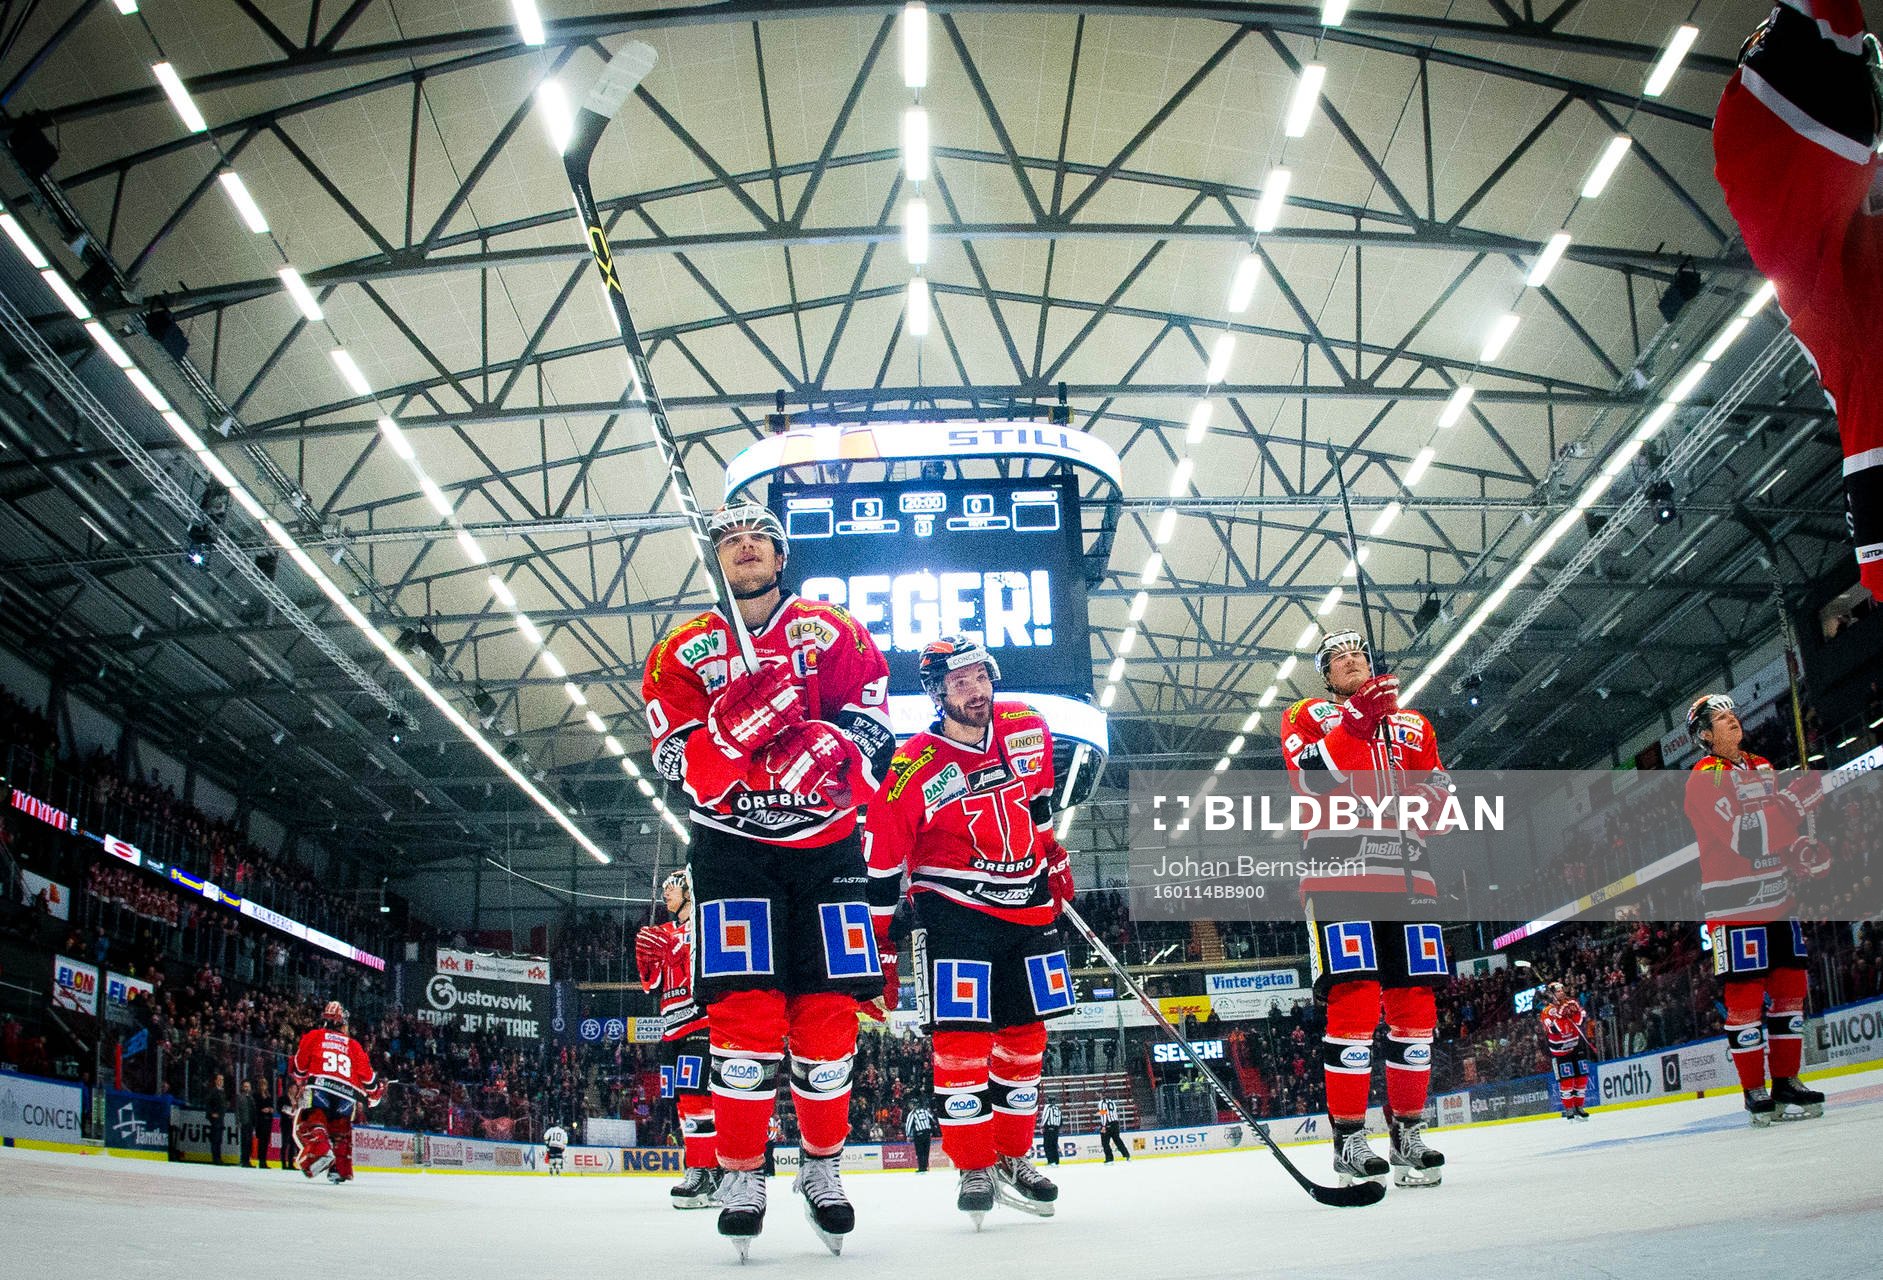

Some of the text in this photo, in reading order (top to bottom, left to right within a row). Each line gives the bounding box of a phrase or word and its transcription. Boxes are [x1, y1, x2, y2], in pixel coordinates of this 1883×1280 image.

[949, 429, 1080, 452] STILL
[737, 793, 822, 811] ÖREBRO
[974, 857, 1034, 873] ÖREBRO
[60, 966, 94, 994] ELON
[1213, 974, 1294, 989] Vintergatan
[426, 975, 532, 1013] Gustavsvik
[322, 1051, 351, 1078] 33
[1154, 1132, 1209, 1146] HOIST
